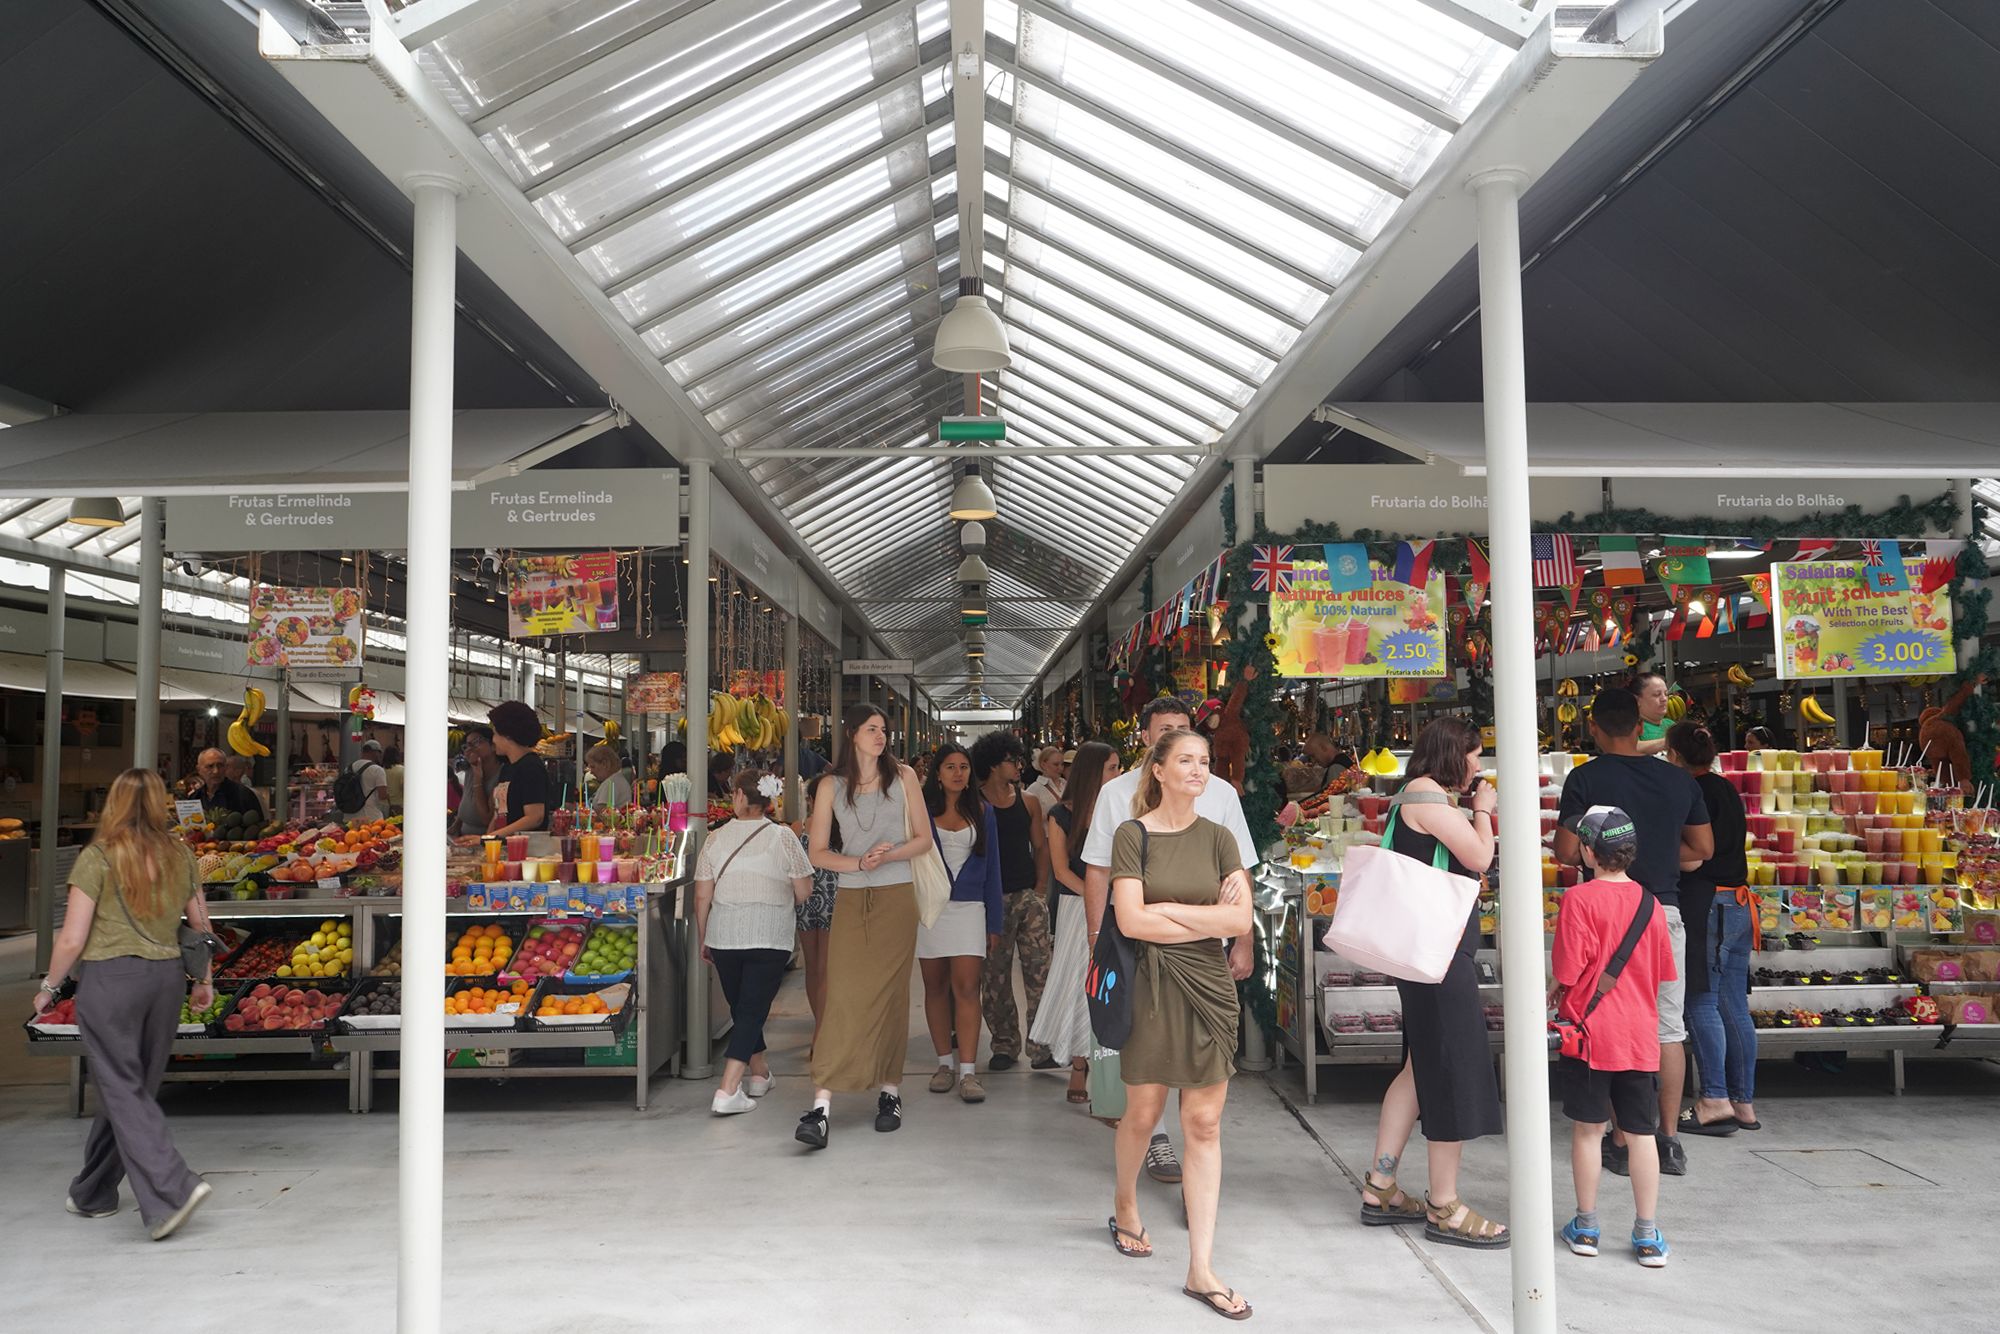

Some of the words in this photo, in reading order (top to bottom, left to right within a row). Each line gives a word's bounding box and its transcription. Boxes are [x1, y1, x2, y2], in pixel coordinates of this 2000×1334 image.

[229, 495, 274, 508] Frutas
[277, 494, 352, 507] Ermelinda
[490, 492, 535, 505] Frutas
[539, 491, 613, 505] Ermelinda
[1371, 495, 1426, 508] Frutaria
[1429, 496, 1448, 508] do
[1451, 495, 1488, 508] Bolhã
[1717, 494, 1772, 507] Frutaria
[1775, 494, 1794, 507] do
[1797, 494, 1845, 507] Bolhão
[245, 513, 257, 526] &
[260, 512, 334, 525] Gertrudes
[507, 509, 518, 523] &
[522, 509, 596, 522] Gertrudes
[1785, 564, 1856, 581] Saladas
[1348, 588, 1405, 602] Juices
[1782, 586, 1836, 608] Fruit
[1314, 605, 1347, 616] 100%
[1351, 605, 1397, 616] Natural
[1823, 606, 1851, 618] With
[1855, 606, 1879, 617] The
[1881, 605, 1909, 616] Best
[1829, 619, 1867, 628] Selection
[1869, 619, 1879, 627] Of
[1881, 618, 1904, 627] Fruits
